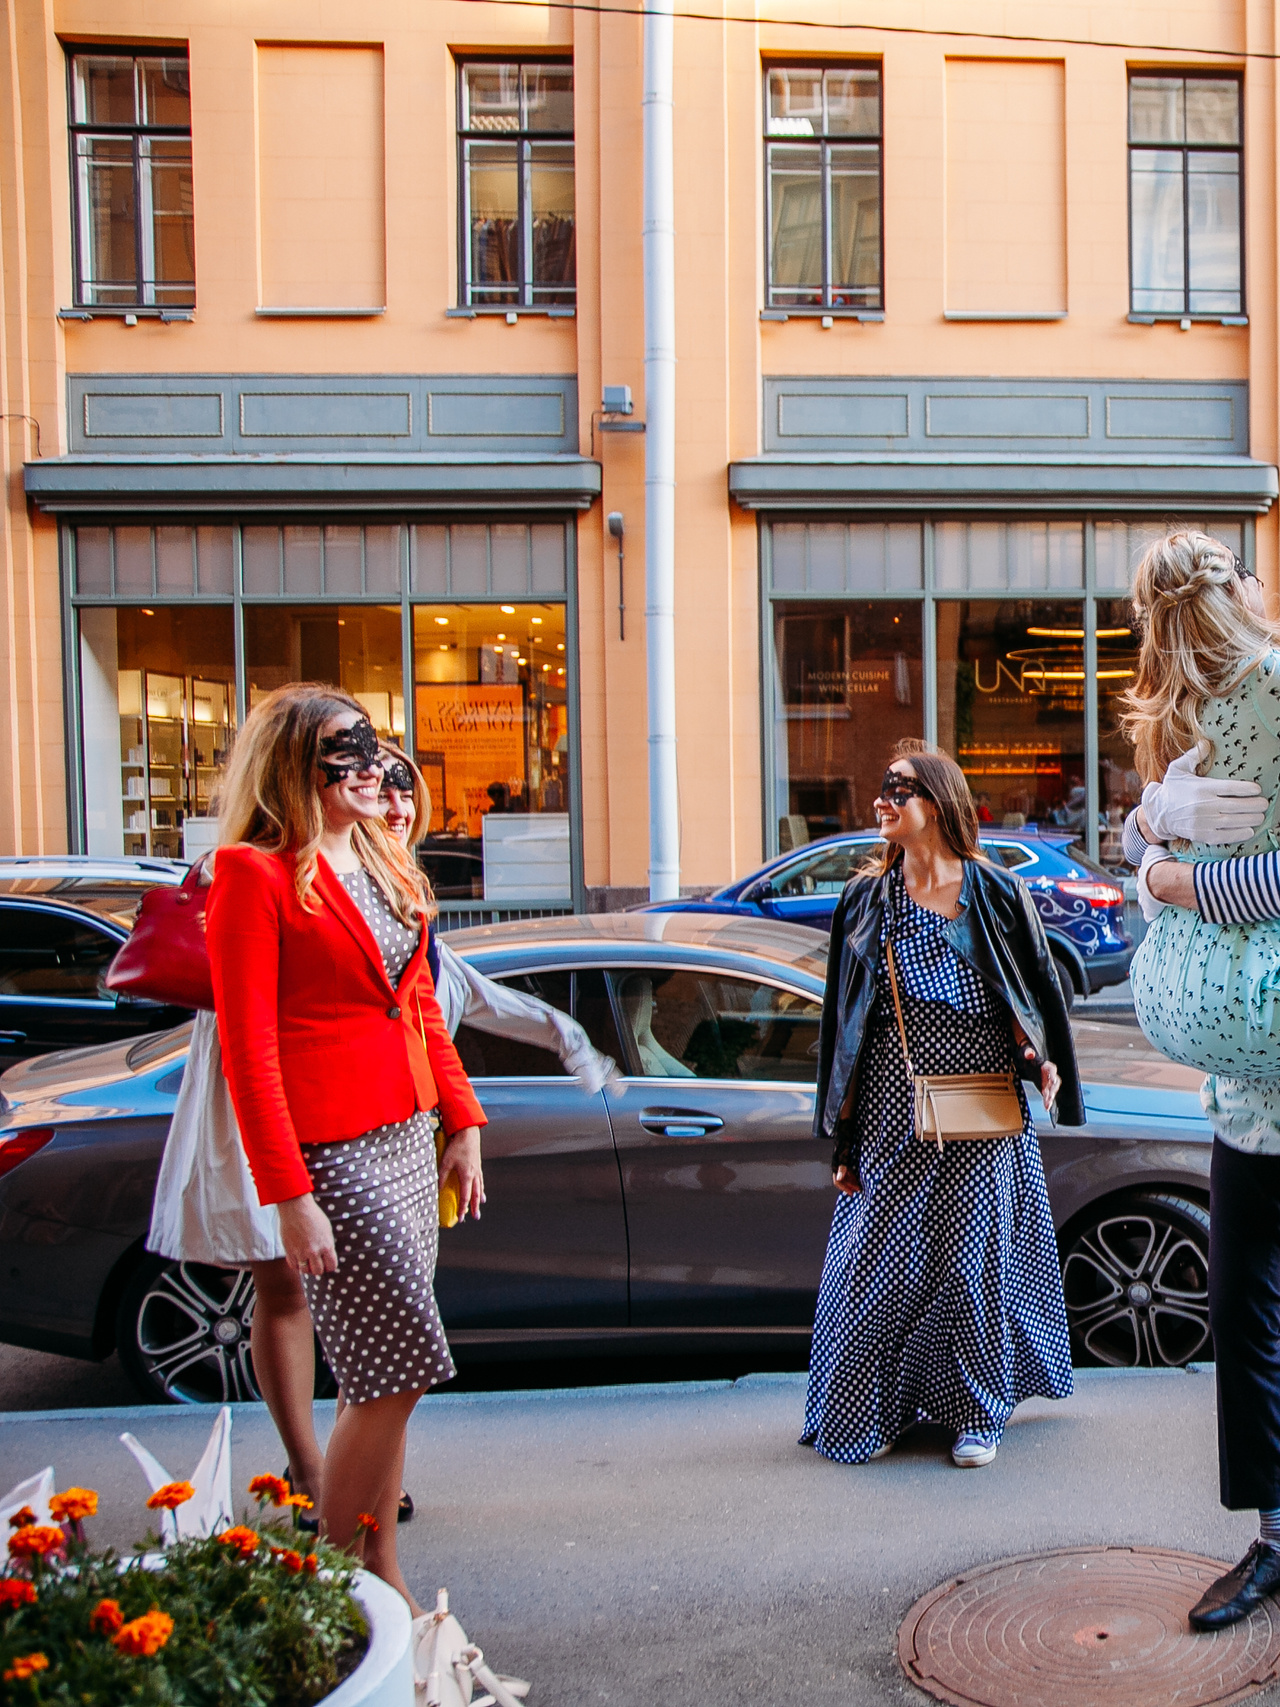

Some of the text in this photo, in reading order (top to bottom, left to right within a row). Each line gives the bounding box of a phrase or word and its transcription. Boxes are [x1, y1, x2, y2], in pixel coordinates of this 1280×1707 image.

[807, 670, 889, 681] MODERN CUISINE
[819, 683, 880, 693] WINE CELLAR
